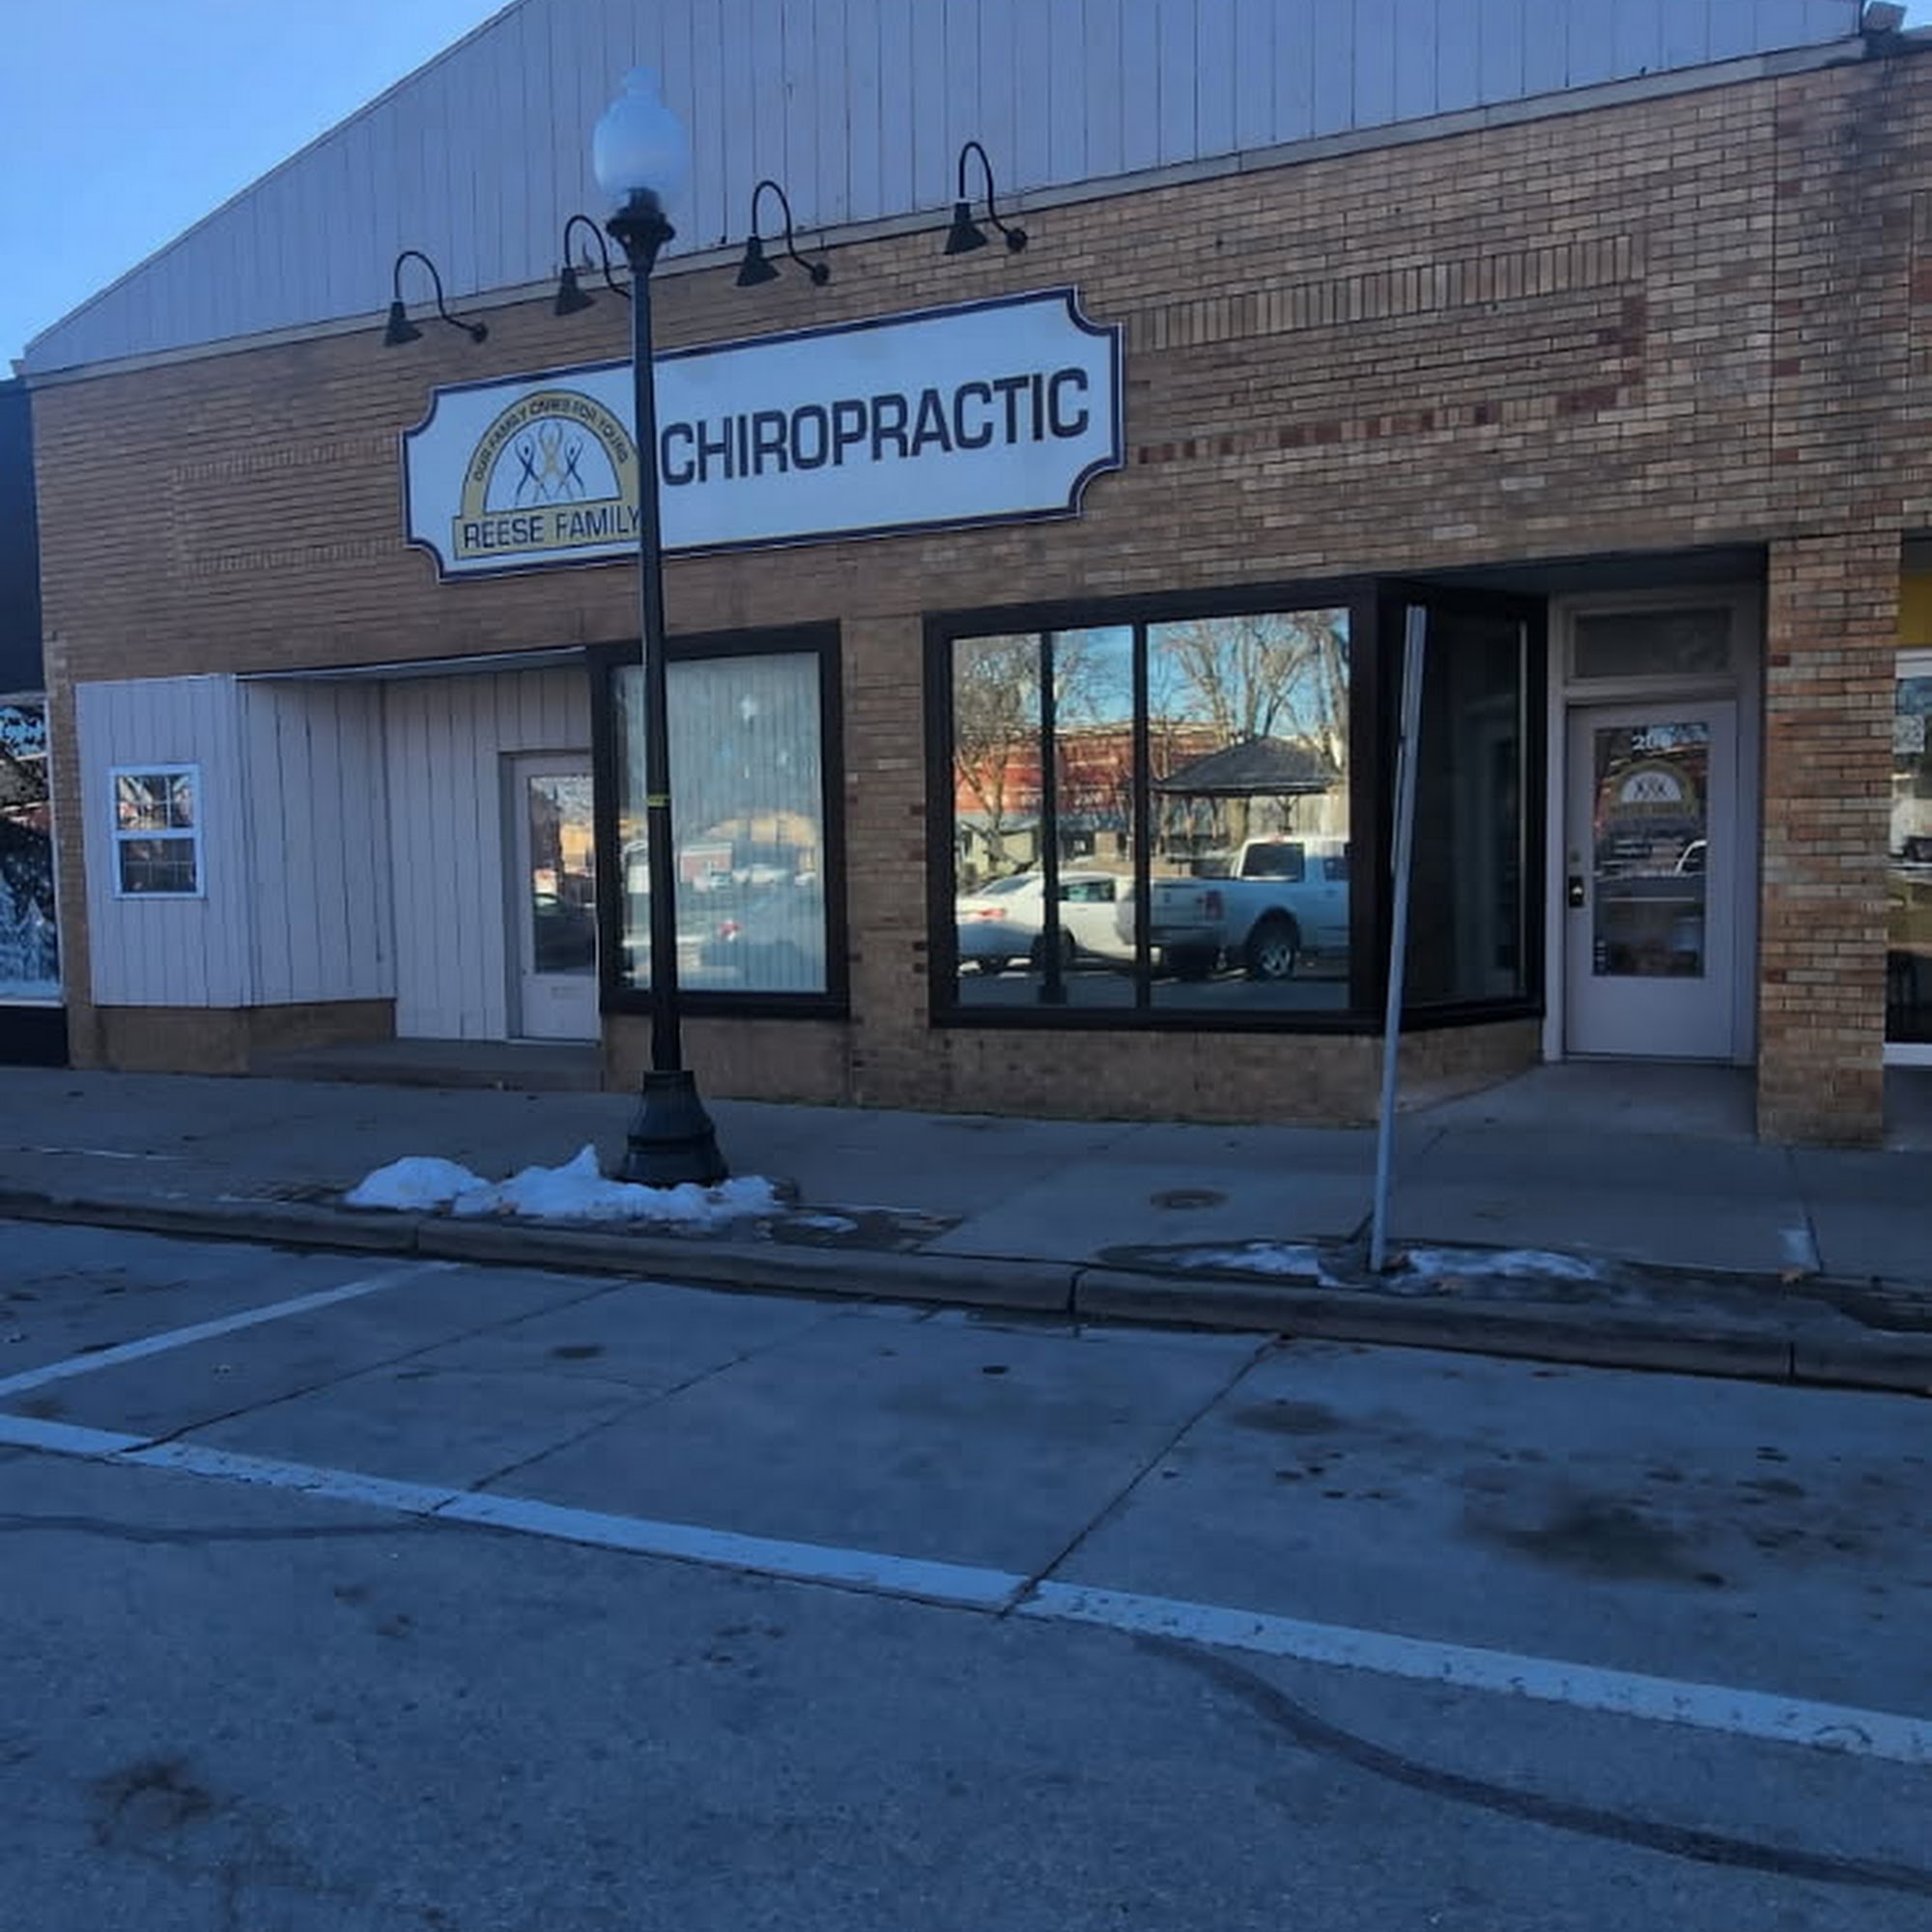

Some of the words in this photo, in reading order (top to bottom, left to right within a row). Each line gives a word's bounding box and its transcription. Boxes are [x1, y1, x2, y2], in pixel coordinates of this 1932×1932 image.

[473, 448, 492, 481] OUR
[488, 406, 526, 448] FAMILY
[661, 367, 1089, 486] CHIROPRACTIC
[463, 515, 544, 549] REESE
[555, 505, 640, 540] FAMILY
